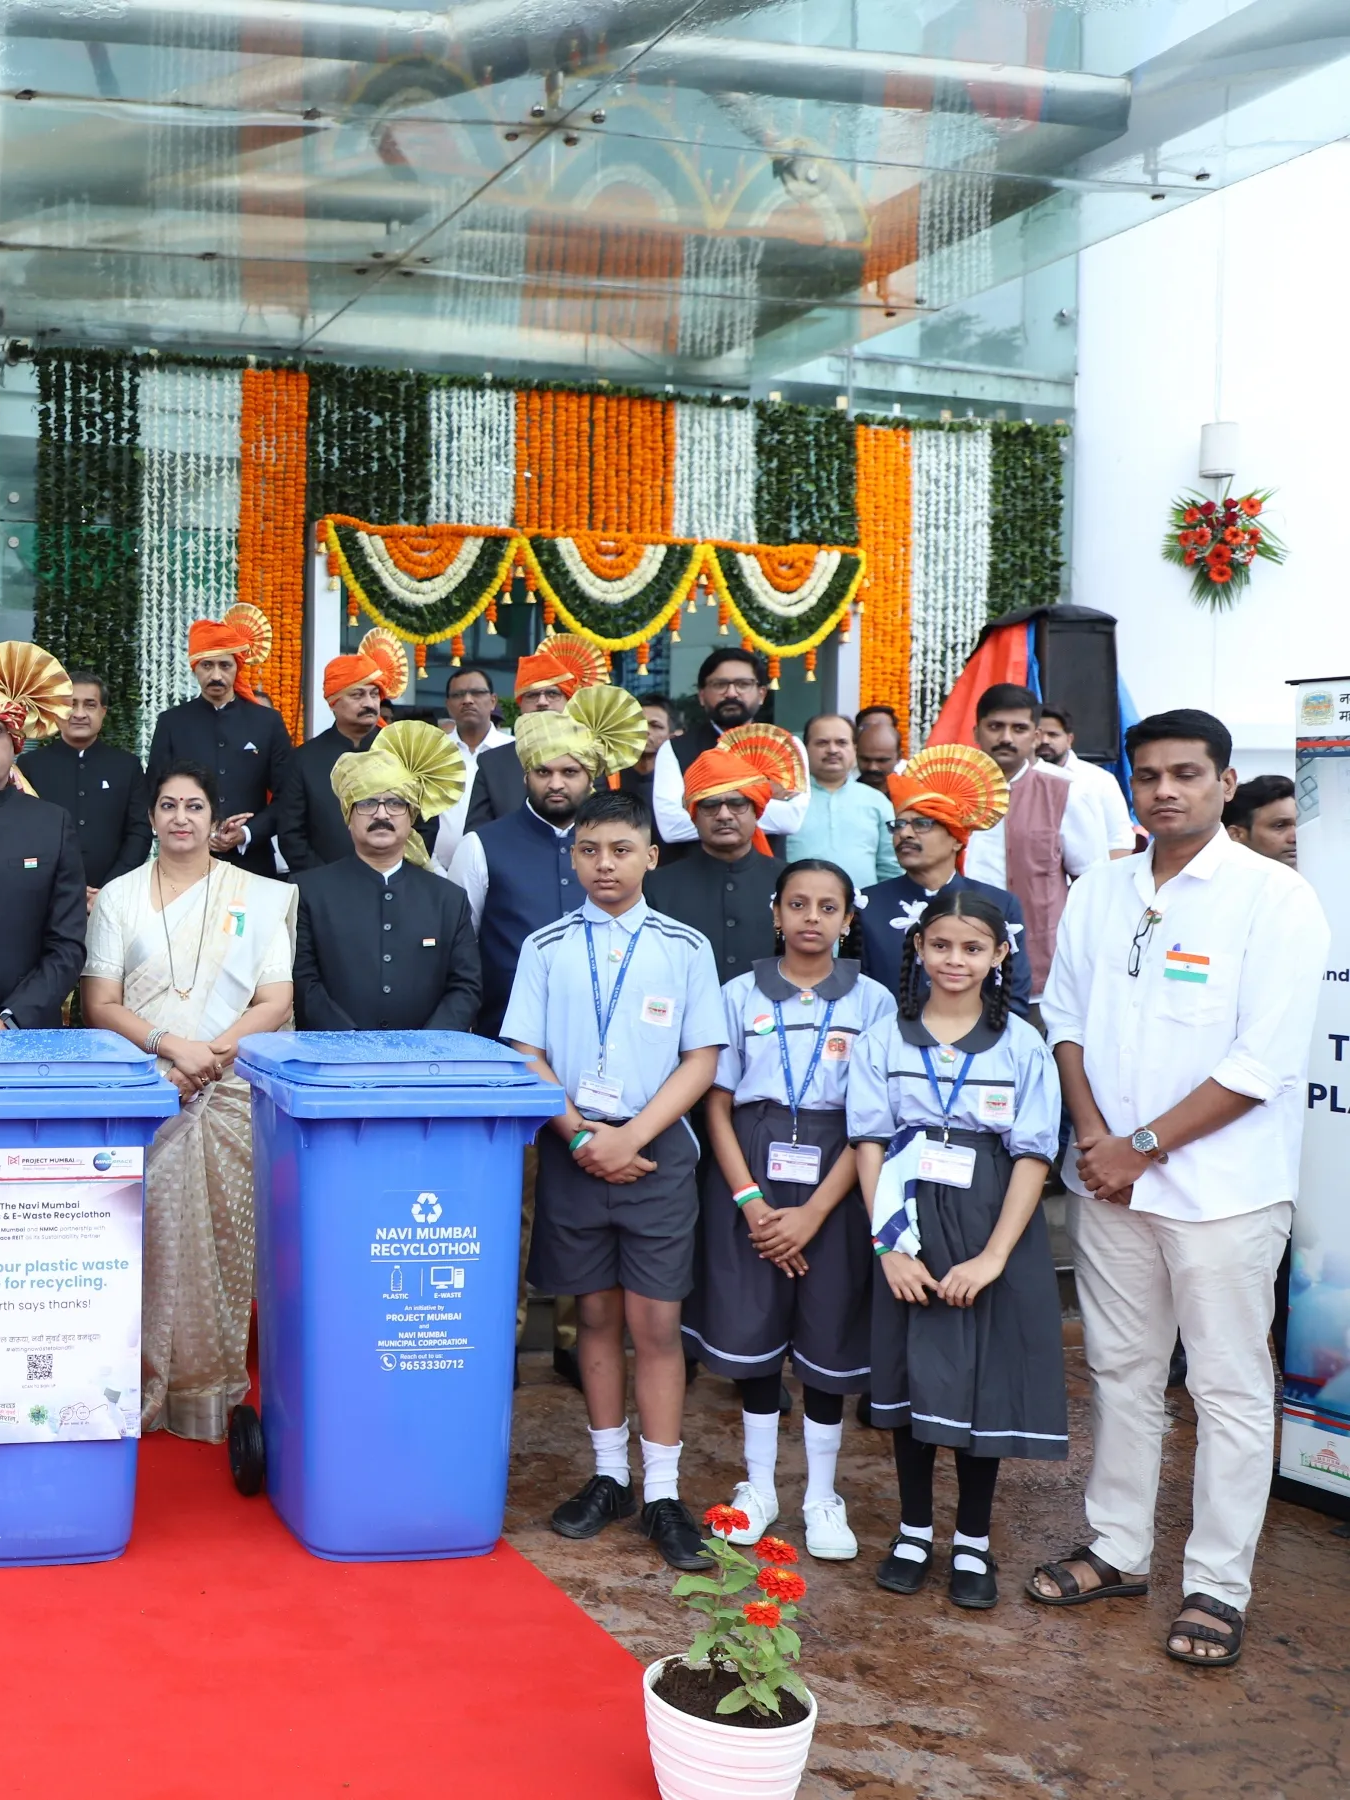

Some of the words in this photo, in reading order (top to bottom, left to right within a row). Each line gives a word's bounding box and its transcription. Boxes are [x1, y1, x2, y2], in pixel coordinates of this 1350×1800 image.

[1322, 968, 1350, 982] nd
[1307, 1082, 1350, 1114] PL
[42, 1201, 80, 1209] Mumbai
[54, 1210, 110, 1220] Recyclothon
[376, 1228, 412, 1240] NAVI
[416, 1227, 477, 1239] MUMBAI
[371, 1242, 480, 1256] RECYCLOTHON
[25, 1259, 78, 1275] plastic
[82, 1259, 129, 1270] waste
[5, 1277, 26, 1289] for
[30, 1275, 107, 1292] recycling.
[19, 1302, 45, 1312] says
[49, 1300, 91, 1309] thanks!
[386, 1314, 424, 1322] PROJECT
[427, 1313, 462, 1321] MUMBAI
[418, 1338, 467, 1346] CORPORATION
[400, 1360, 464, 1370] 9653330712
